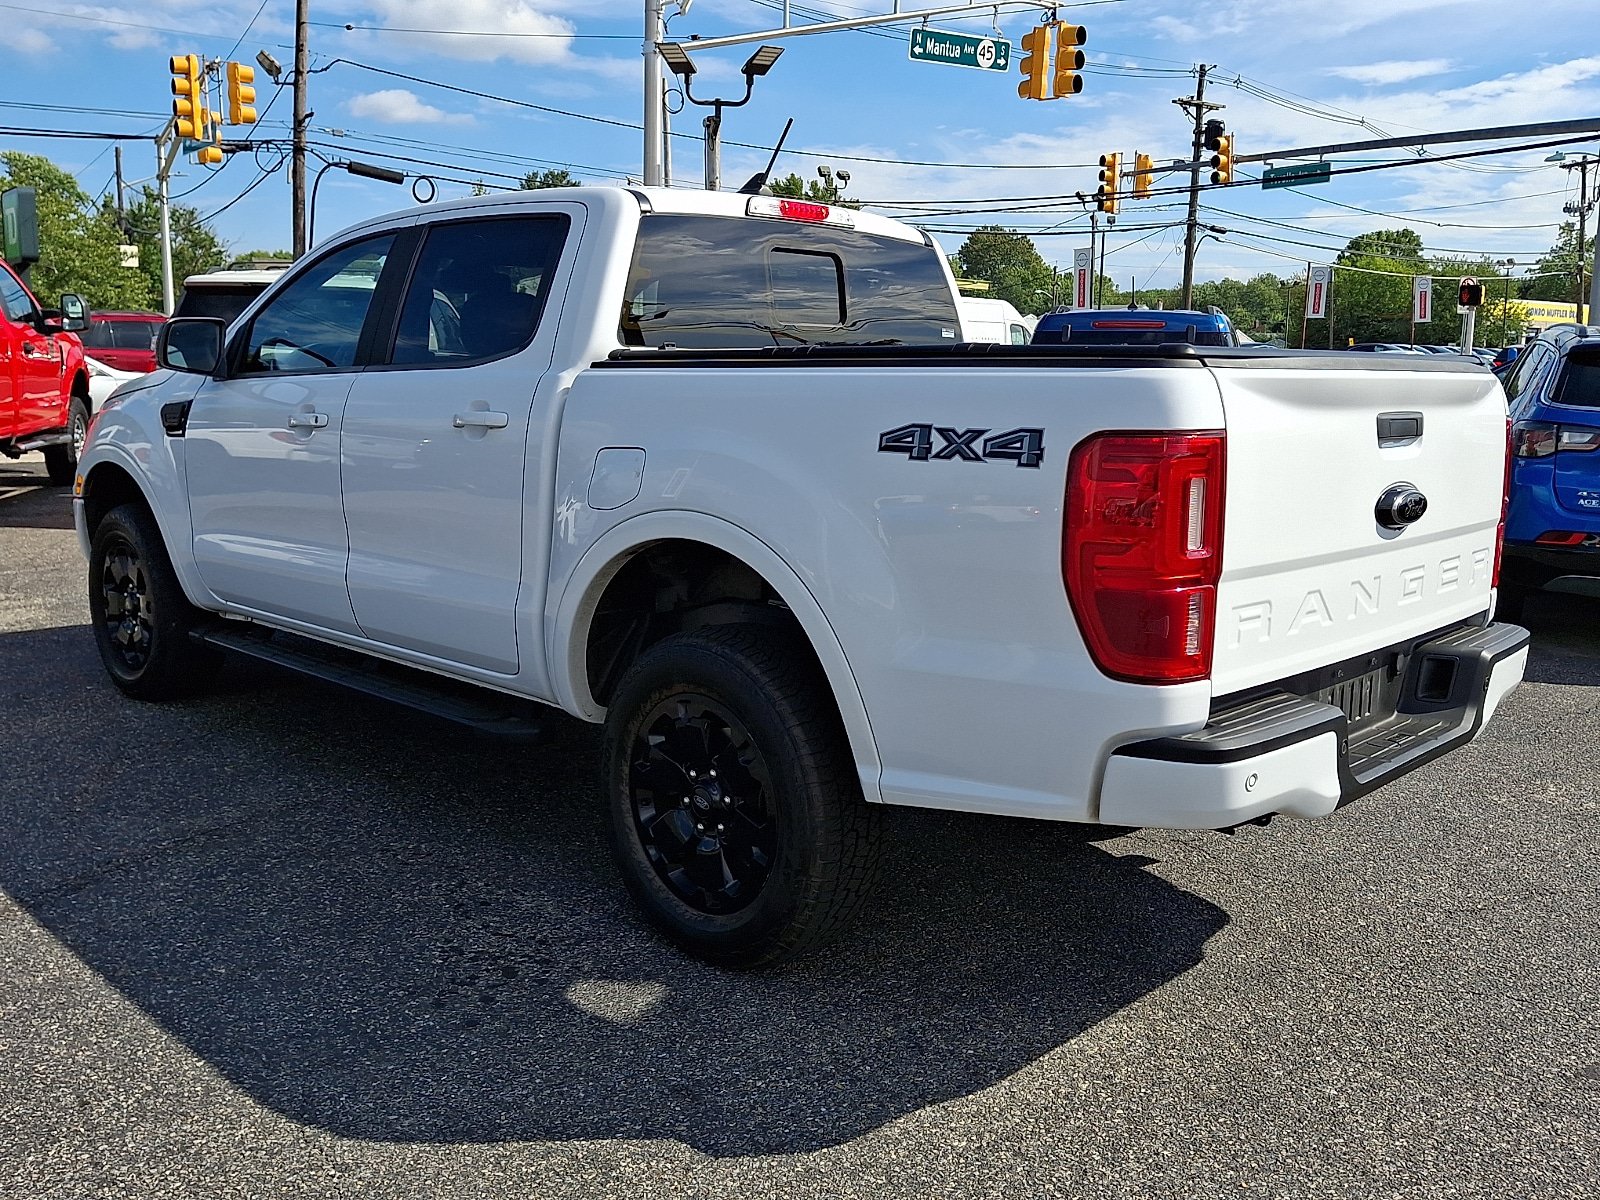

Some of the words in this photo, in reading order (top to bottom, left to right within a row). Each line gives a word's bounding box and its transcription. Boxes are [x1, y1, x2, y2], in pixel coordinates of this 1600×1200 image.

[916, 33, 922, 44] N
[926, 37, 961, 58] Mantua
[963, 43, 975, 55] Ave
[979, 45, 993, 61] 45
[1000, 45, 1006, 56] S
[1547, 309, 1568, 319] MUFFLER
[1227, 547, 1491, 650] RANGER
